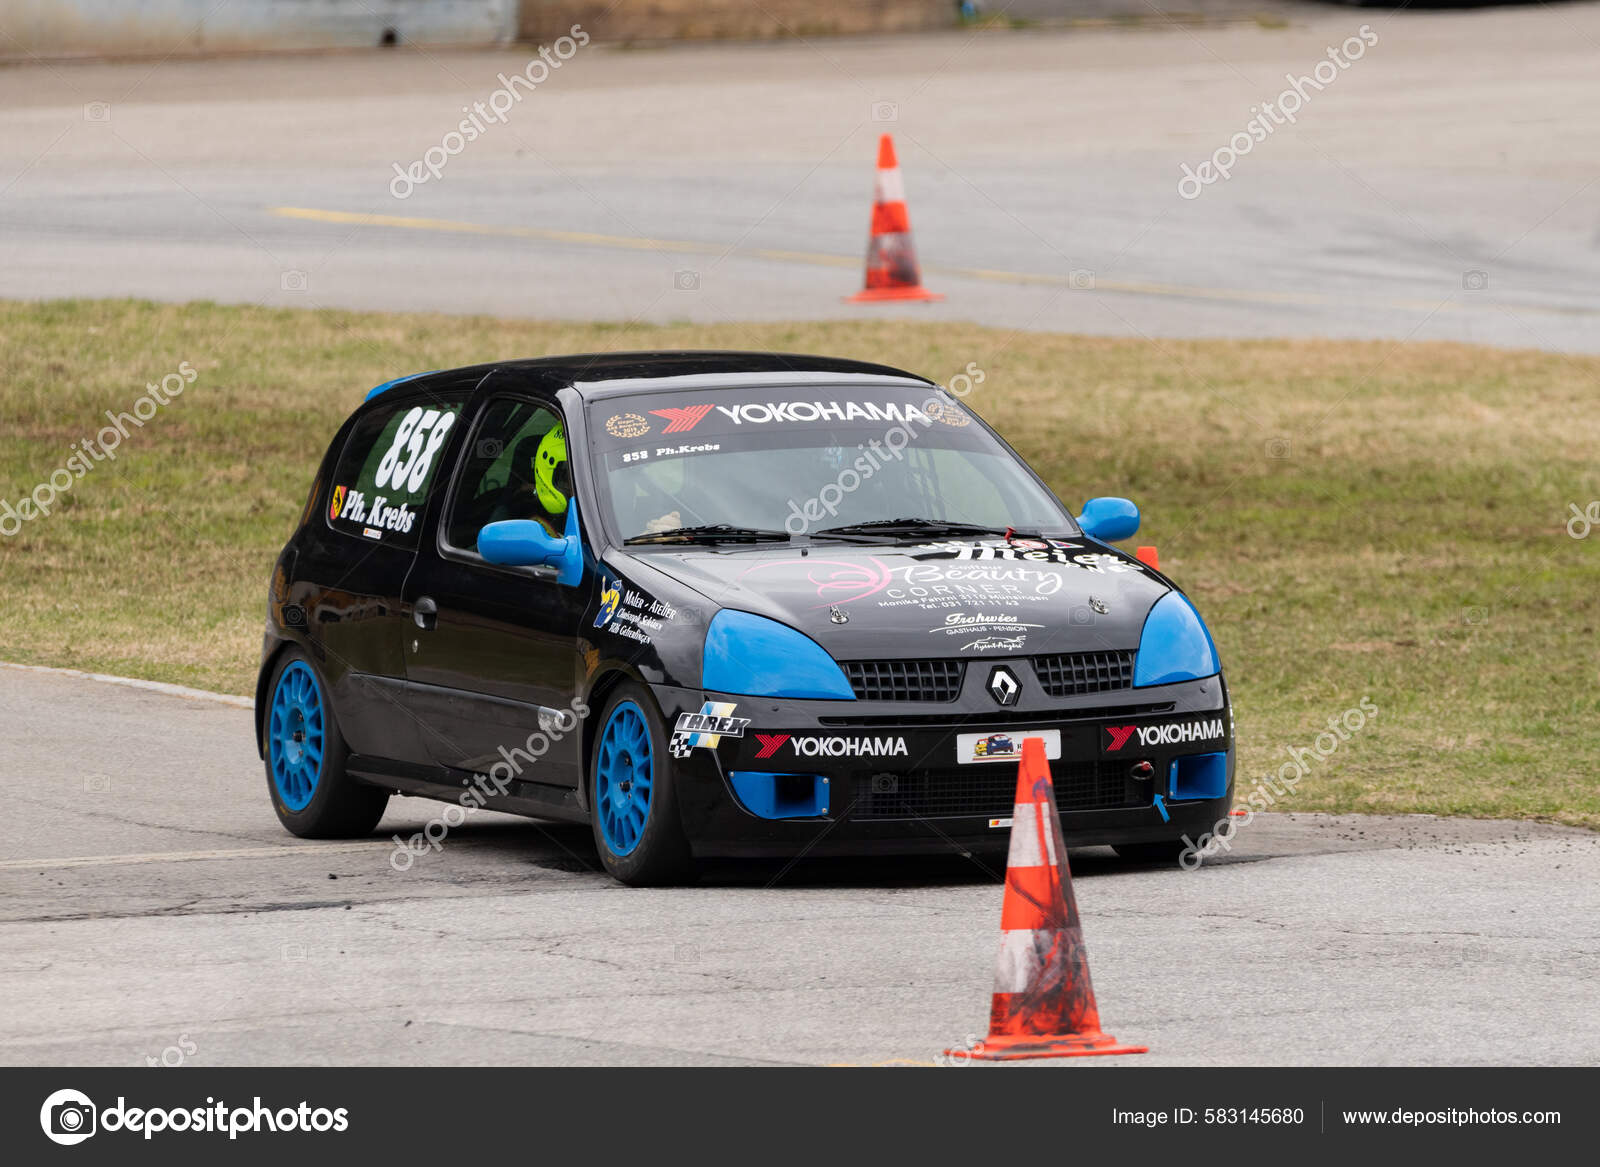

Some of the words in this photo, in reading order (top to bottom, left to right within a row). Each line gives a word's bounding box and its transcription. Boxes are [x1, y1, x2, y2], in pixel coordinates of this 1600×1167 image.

[716, 402, 933, 424] YOKOHAMA
[375, 406, 456, 493] 858
[622, 450, 649, 462] 858
[656, 444, 721, 456] Ph.Krebs
[340, 490, 366, 522] Ph.
[366, 496, 416, 533] Krebs
[889, 565, 1063, 595] Beauty
[887, 584, 1023, 598] CORNER
[878, 599, 919, 608] Monika
[921, 596, 957, 604] Fahrni
[945, 626, 987, 635] GASTHAUS
[1137, 719, 1225, 746] YOKOHAMA
[791, 737, 908, 756] YOKOHAMA
